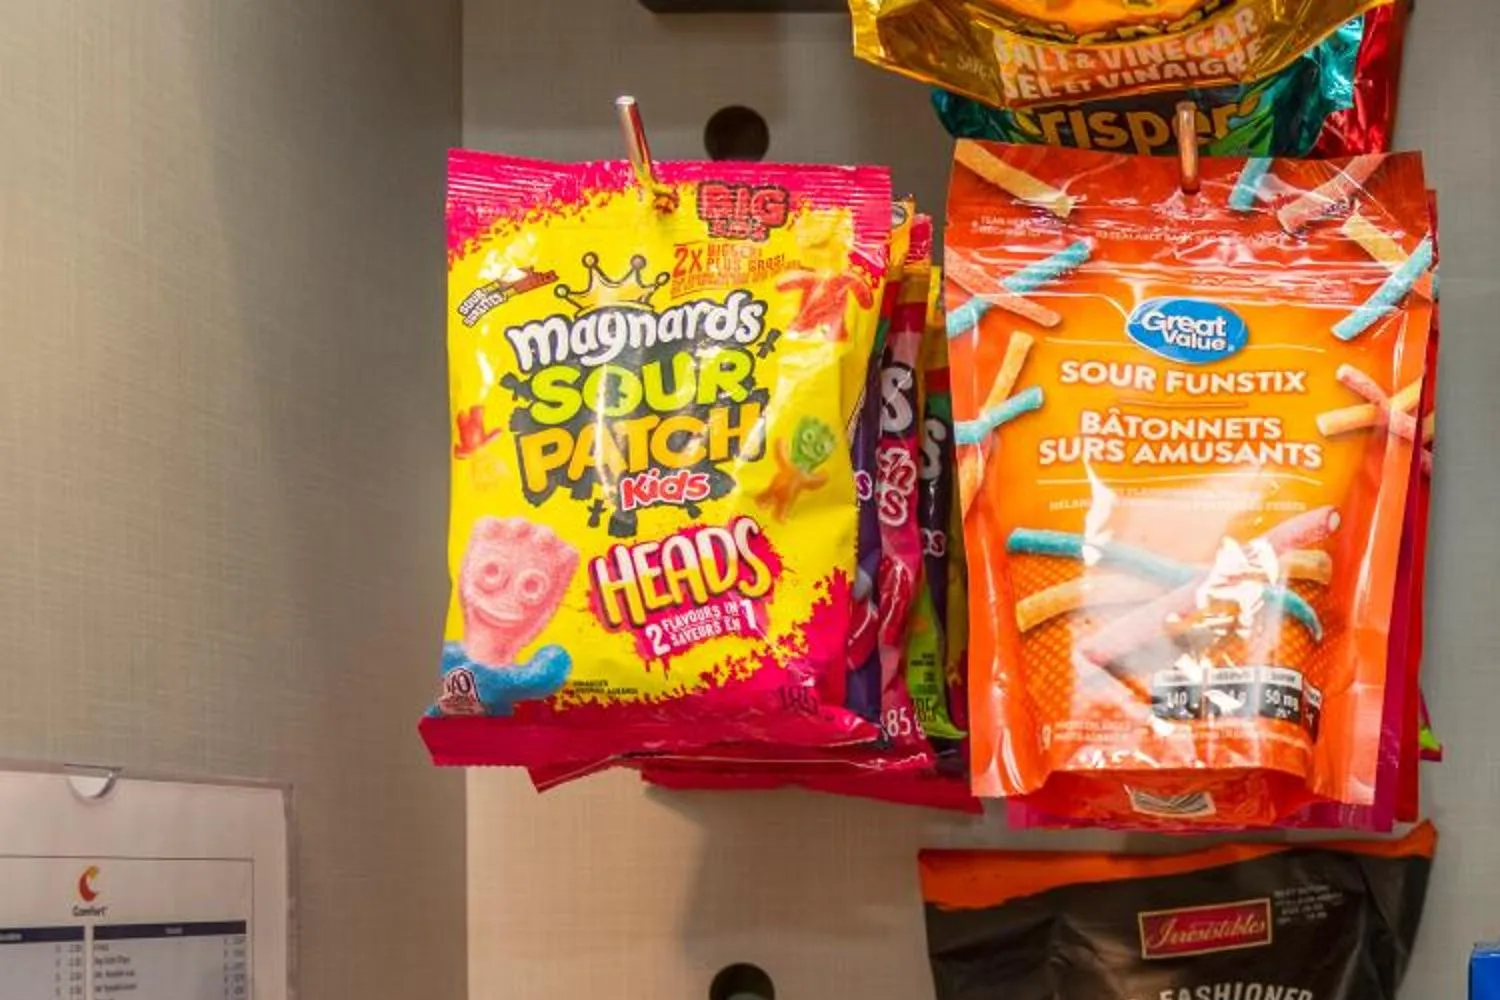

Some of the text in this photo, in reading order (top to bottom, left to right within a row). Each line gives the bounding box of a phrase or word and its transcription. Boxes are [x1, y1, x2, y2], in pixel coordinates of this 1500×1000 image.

[1101, 7, 1258, 70] VINEGAR
[698, 181, 790, 227] BIG
[1141, 311, 1228, 339] Great
[1161, 325, 1229, 352] Value
[529, 346, 754, 425] SOUR
[1060, 361, 1307, 394] SOUR FUNSTIX
[1080, 408, 1283, 440] BÂTONNETS
[520, 402, 768, 494] PATCH
[1038, 438, 1323, 468] SURS AMUSANTS
[620, 466, 712, 510] Kids
[592, 518, 773, 630] HEADS
[645, 623, 671, 656] 2
[661, 605, 722, 633] FLAVOURS
[670, 619, 723, 647] SAVEURS
[72, 905, 108, 917] Comfort
